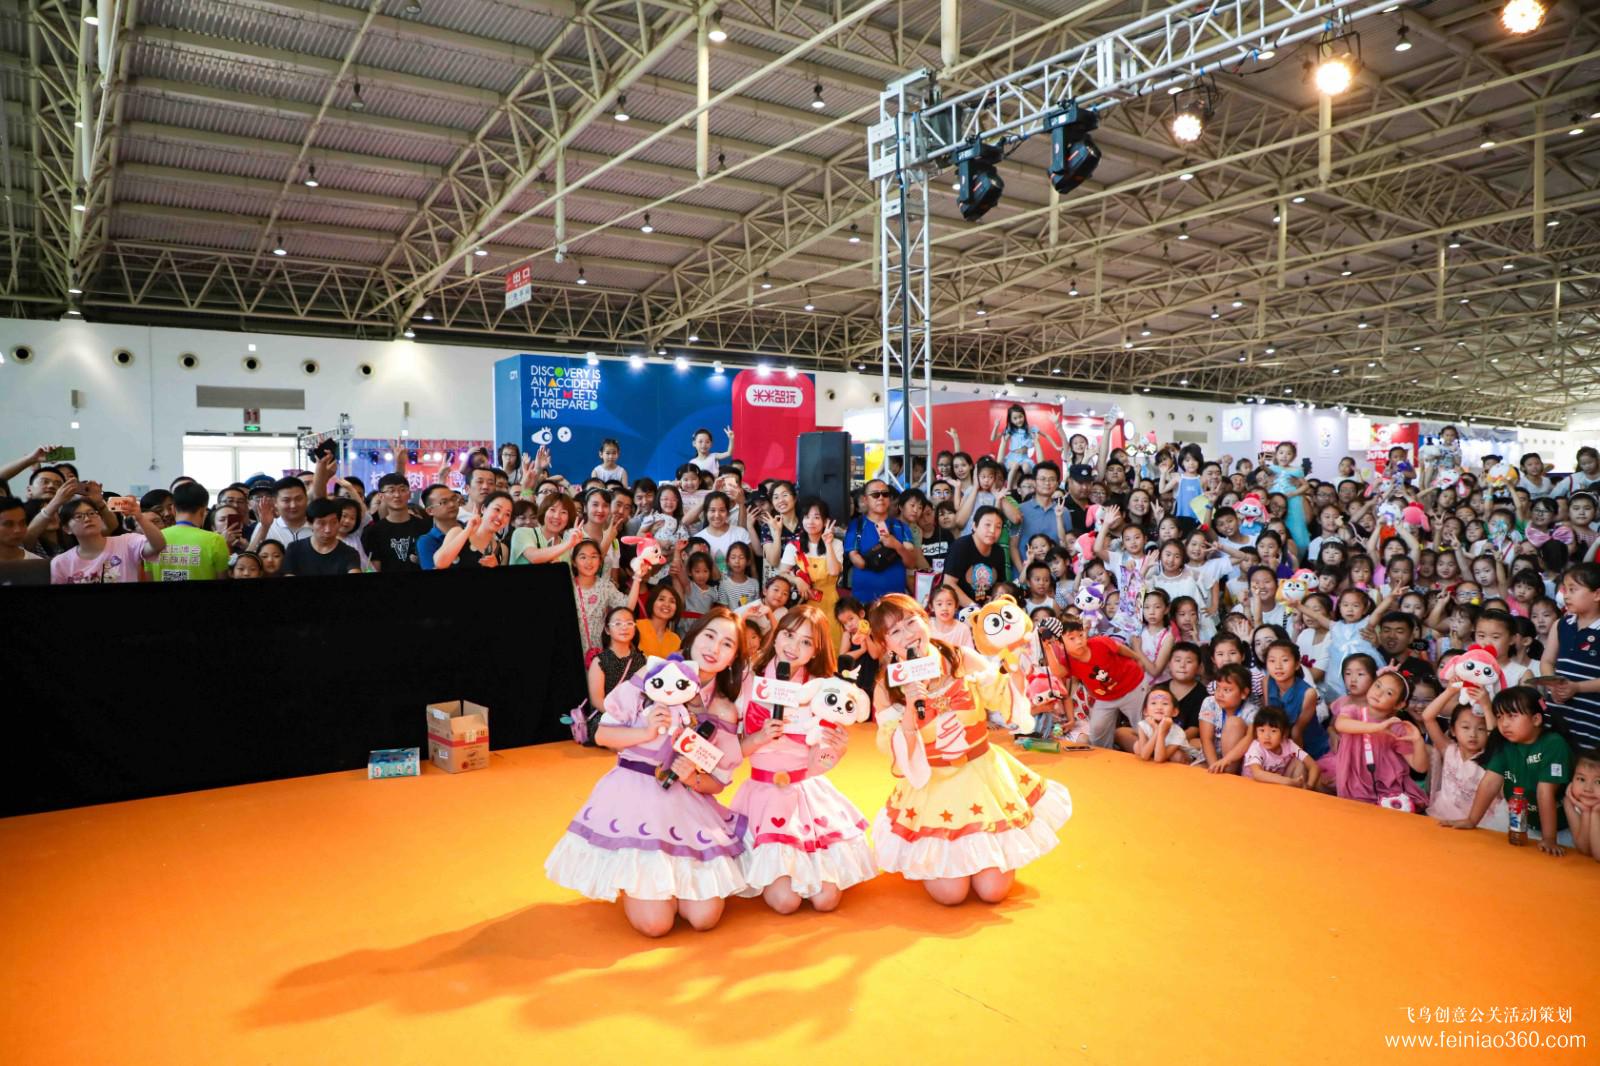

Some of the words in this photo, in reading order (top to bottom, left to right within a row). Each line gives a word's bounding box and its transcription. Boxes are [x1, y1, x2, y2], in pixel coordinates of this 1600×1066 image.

[513, 267, 530, 283] 出口
[530, 365, 590, 379] DISCOVERY
[592, 369, 601, 379] IS
[530, 377, 547, 387] AN
[548, 378, 601, 389] ACCIDENT
[531, 387, 560, 398] THAT
[563, 390, 598, 400] MEETS
[753, 389, 796, 404] 米米智玩
[531, 398, 540, 408] A
[542, 398, 599, 410] PREPARED
[531, 409, 558, 419] MIND
